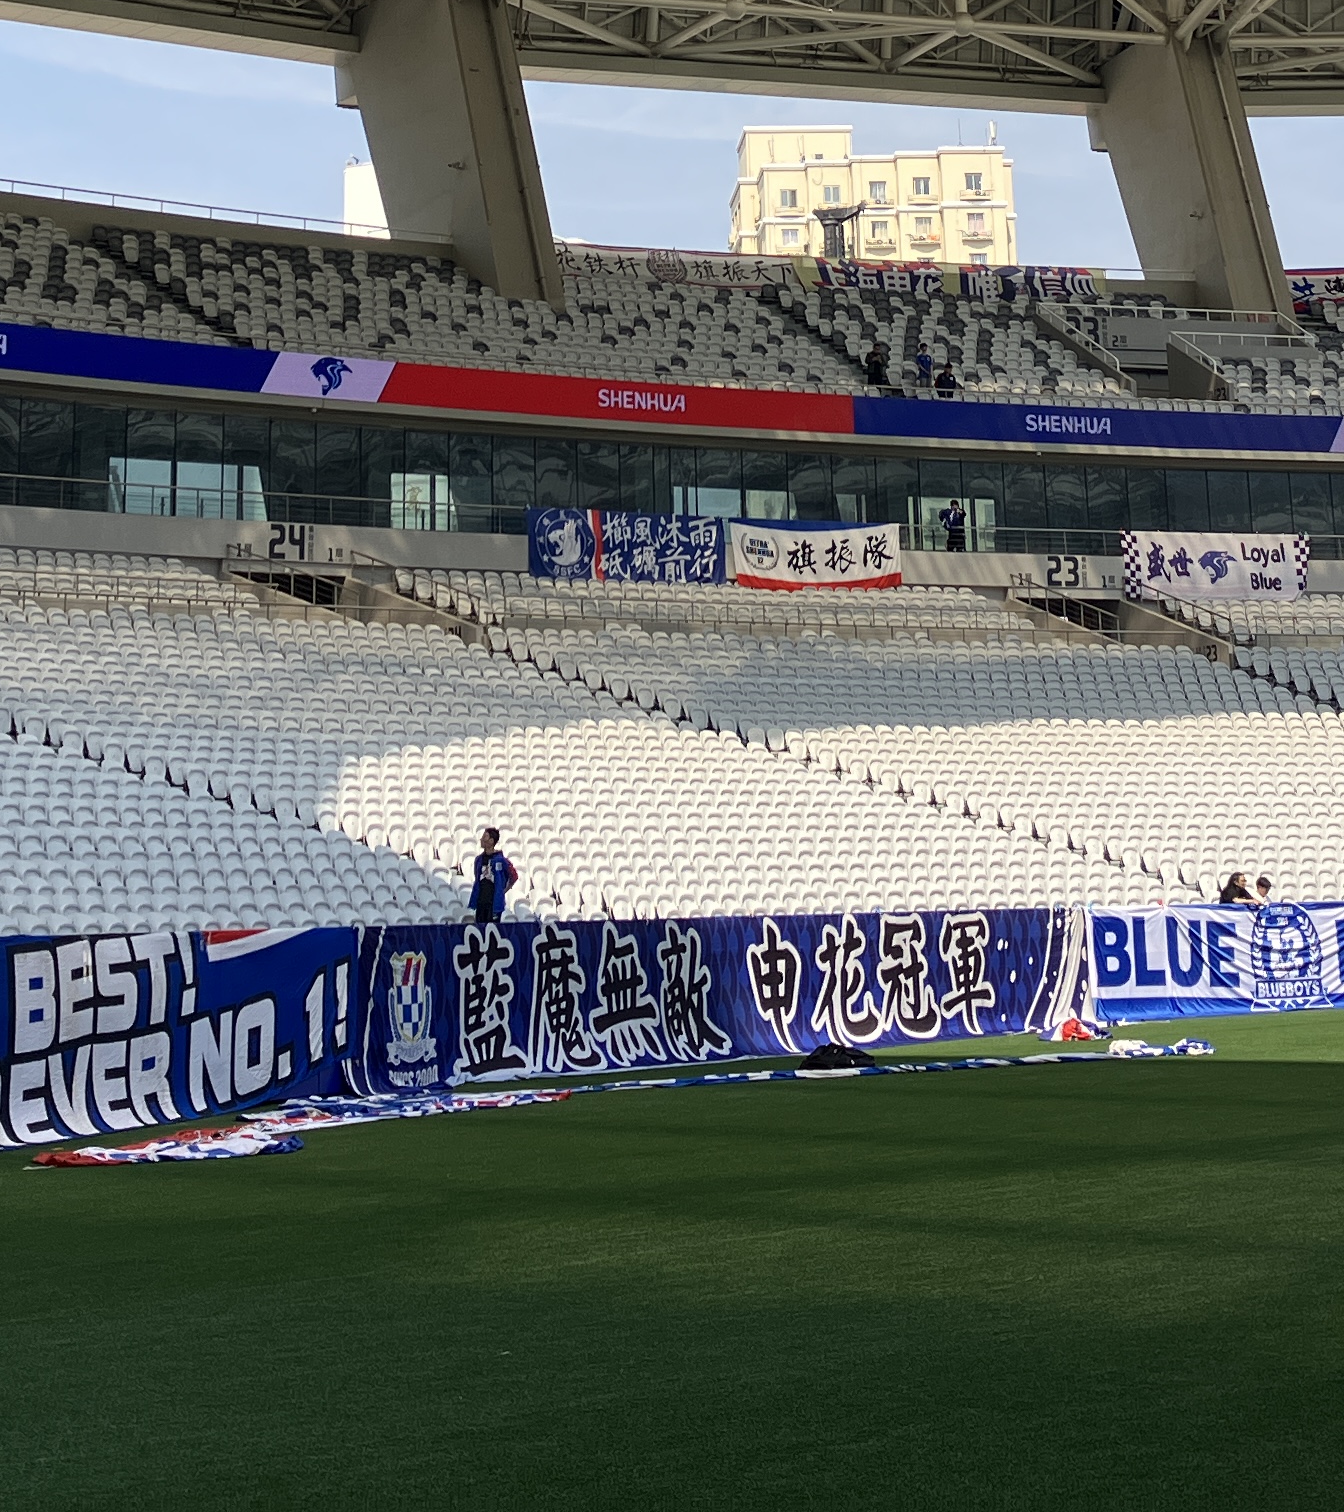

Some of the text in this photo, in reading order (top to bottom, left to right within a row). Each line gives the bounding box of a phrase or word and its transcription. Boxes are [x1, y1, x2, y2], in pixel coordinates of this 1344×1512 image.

[691, 259, 793, 284] 旗振天下
[598, 389, 687, 412] SHENHUA
[1025, 414, 1112, 436] SHENHUA
[268, 523, 306, 560] 24
[786, 533, 894, 575] 旗振隊
[1240, 541, 1286, 568] Loyal
[1047, 555, 1080, 587] 23
[1249, 572, 1283, 591] Blue
[1094, 914, 1240, 989] BLUE
[12, 932, 197, 1055] BEST!
[453, 910, 996, 1083] 藍魔無敵 申花冠軍
[1257, 981, 1320, 999] BLUEBOYS
[188, 996, 292, 1101] NO.
[305, 962, 349, 1065] 1!
